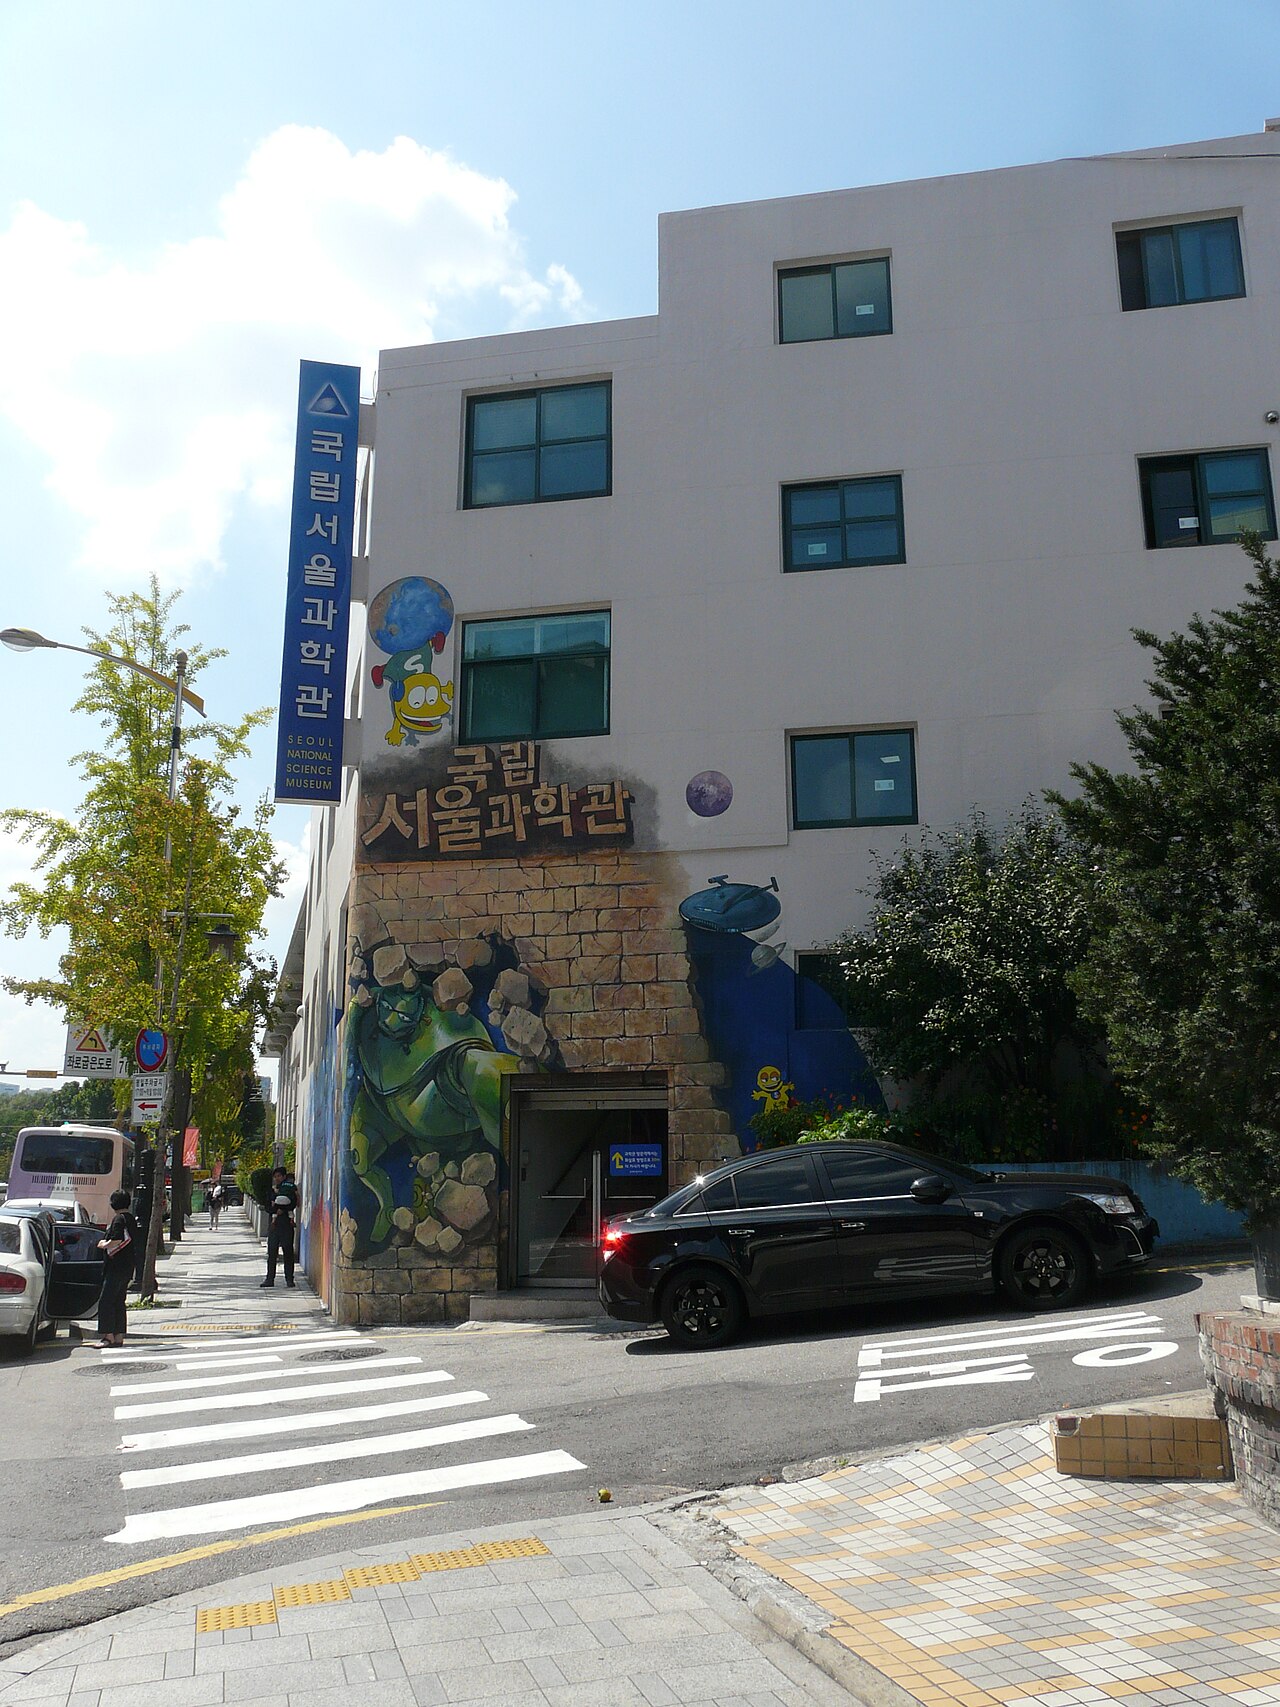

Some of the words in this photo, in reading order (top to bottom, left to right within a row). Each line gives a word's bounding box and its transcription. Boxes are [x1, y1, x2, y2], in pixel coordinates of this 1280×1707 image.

[295, 429, 344, 719] 국립서울과학관
[288, 735, 333, 747] SEOUL
[287, 749, 333, 761] NATIONAL
[286, 763, 333, 776] SCIENCE
[446, 740, 537, 793] 국립
[285, 778, 332, 790] MUSEUM
[360, 779, 631, 853] 서울과학관
